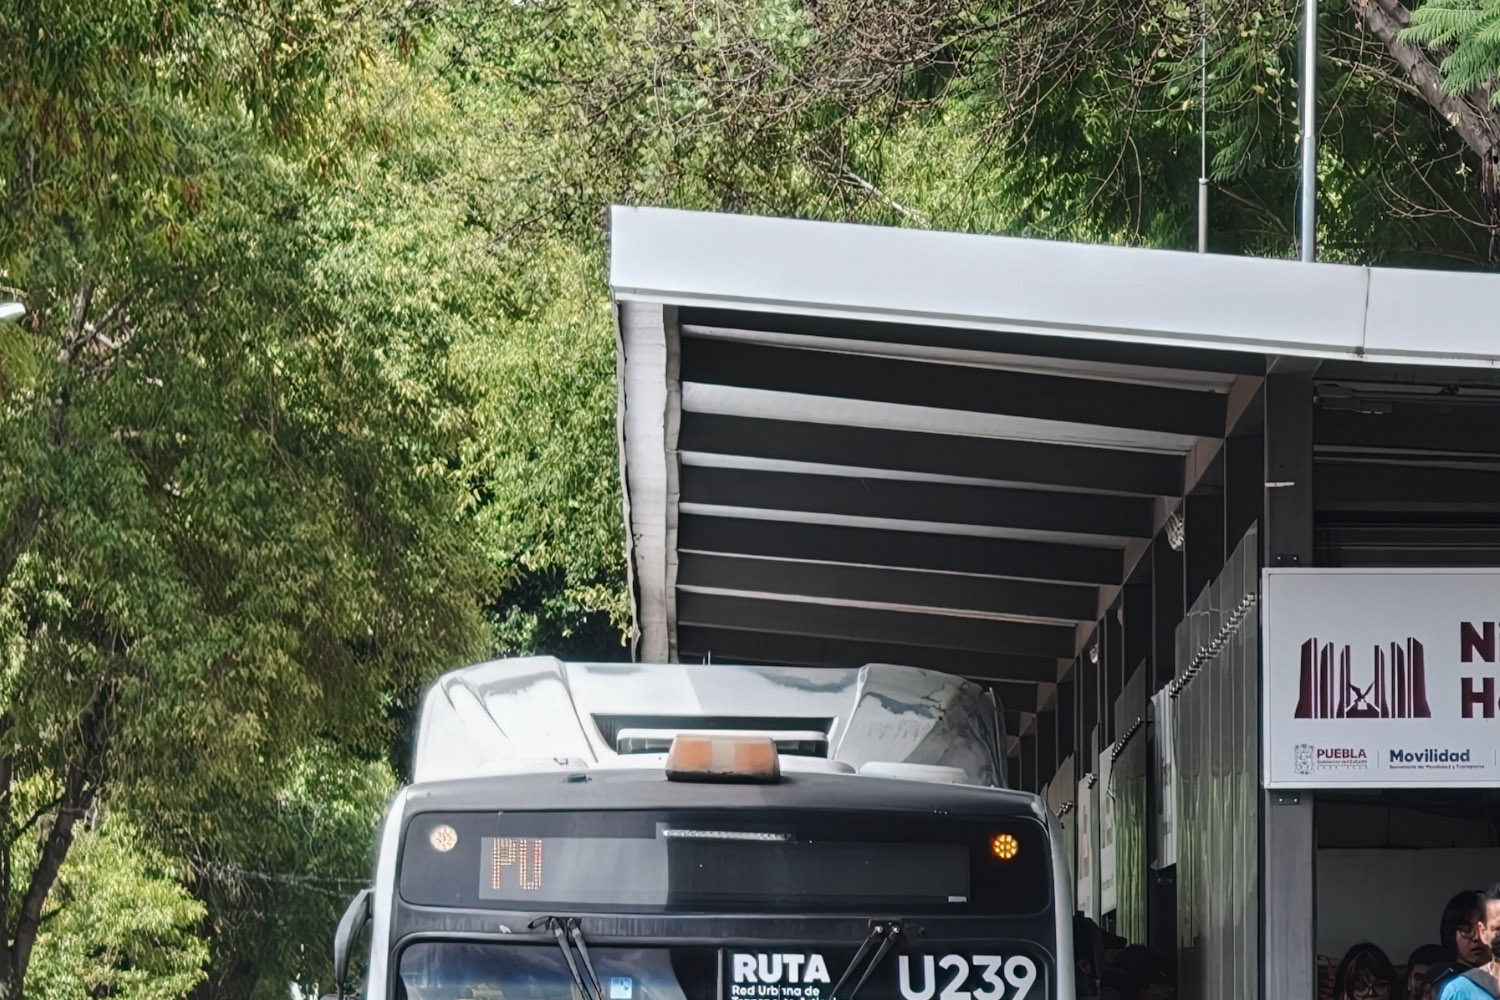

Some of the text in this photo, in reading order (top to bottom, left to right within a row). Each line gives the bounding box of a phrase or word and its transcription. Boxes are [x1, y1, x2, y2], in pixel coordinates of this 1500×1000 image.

[1316, 748, 1367, 759] PUEBLA
[1389, 749, 1471, 763] Movilidad
[733, 953, 831, 983] RUTA
[731, 985, 755, 996] Red
[804, 985, 820, 996] de
